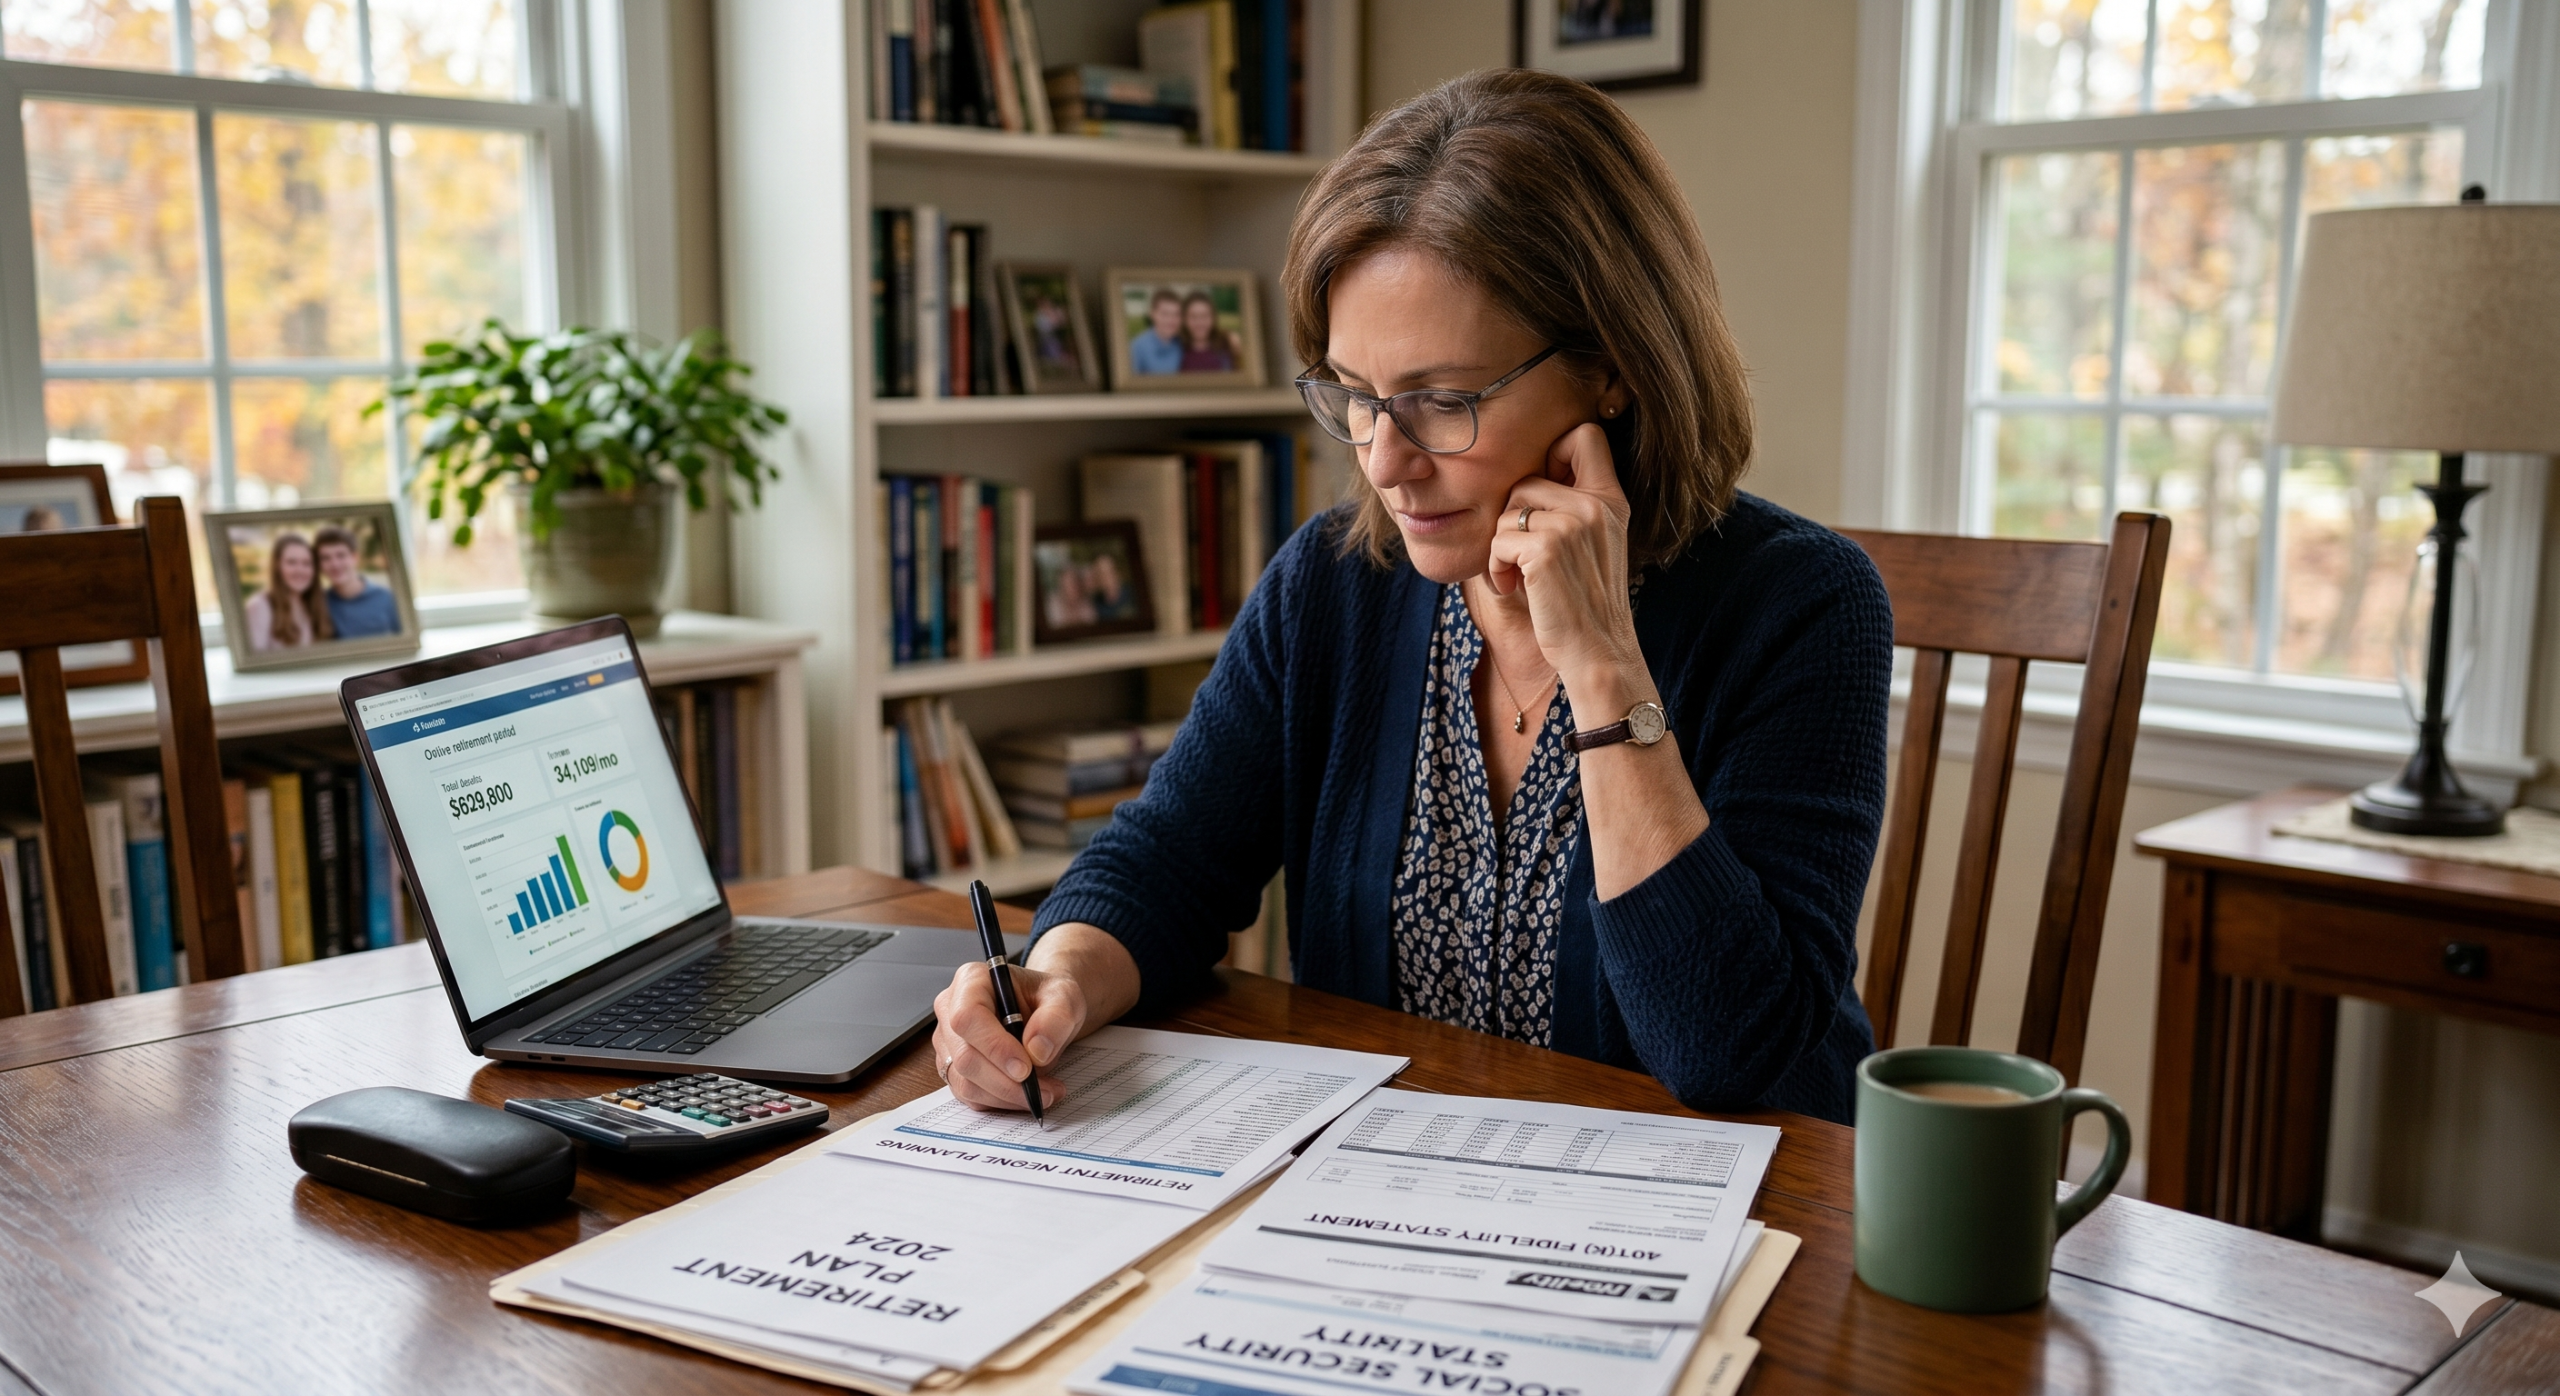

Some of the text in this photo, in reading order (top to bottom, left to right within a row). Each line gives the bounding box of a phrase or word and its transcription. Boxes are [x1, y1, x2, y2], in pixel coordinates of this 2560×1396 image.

[554, 753, 618, 783] 34,109/mo
[449, 782, 513, 820] $629,800
[1304, 1213, 1451, 1237] STATEMENT
[845, 1231, 954, 1261] 2024
[788, 1250, 916, 1284] PLAN
[672, 1257, 962, 1323] RETIREMENT
[1183, 1333, 1398, 1379] SECURITY
